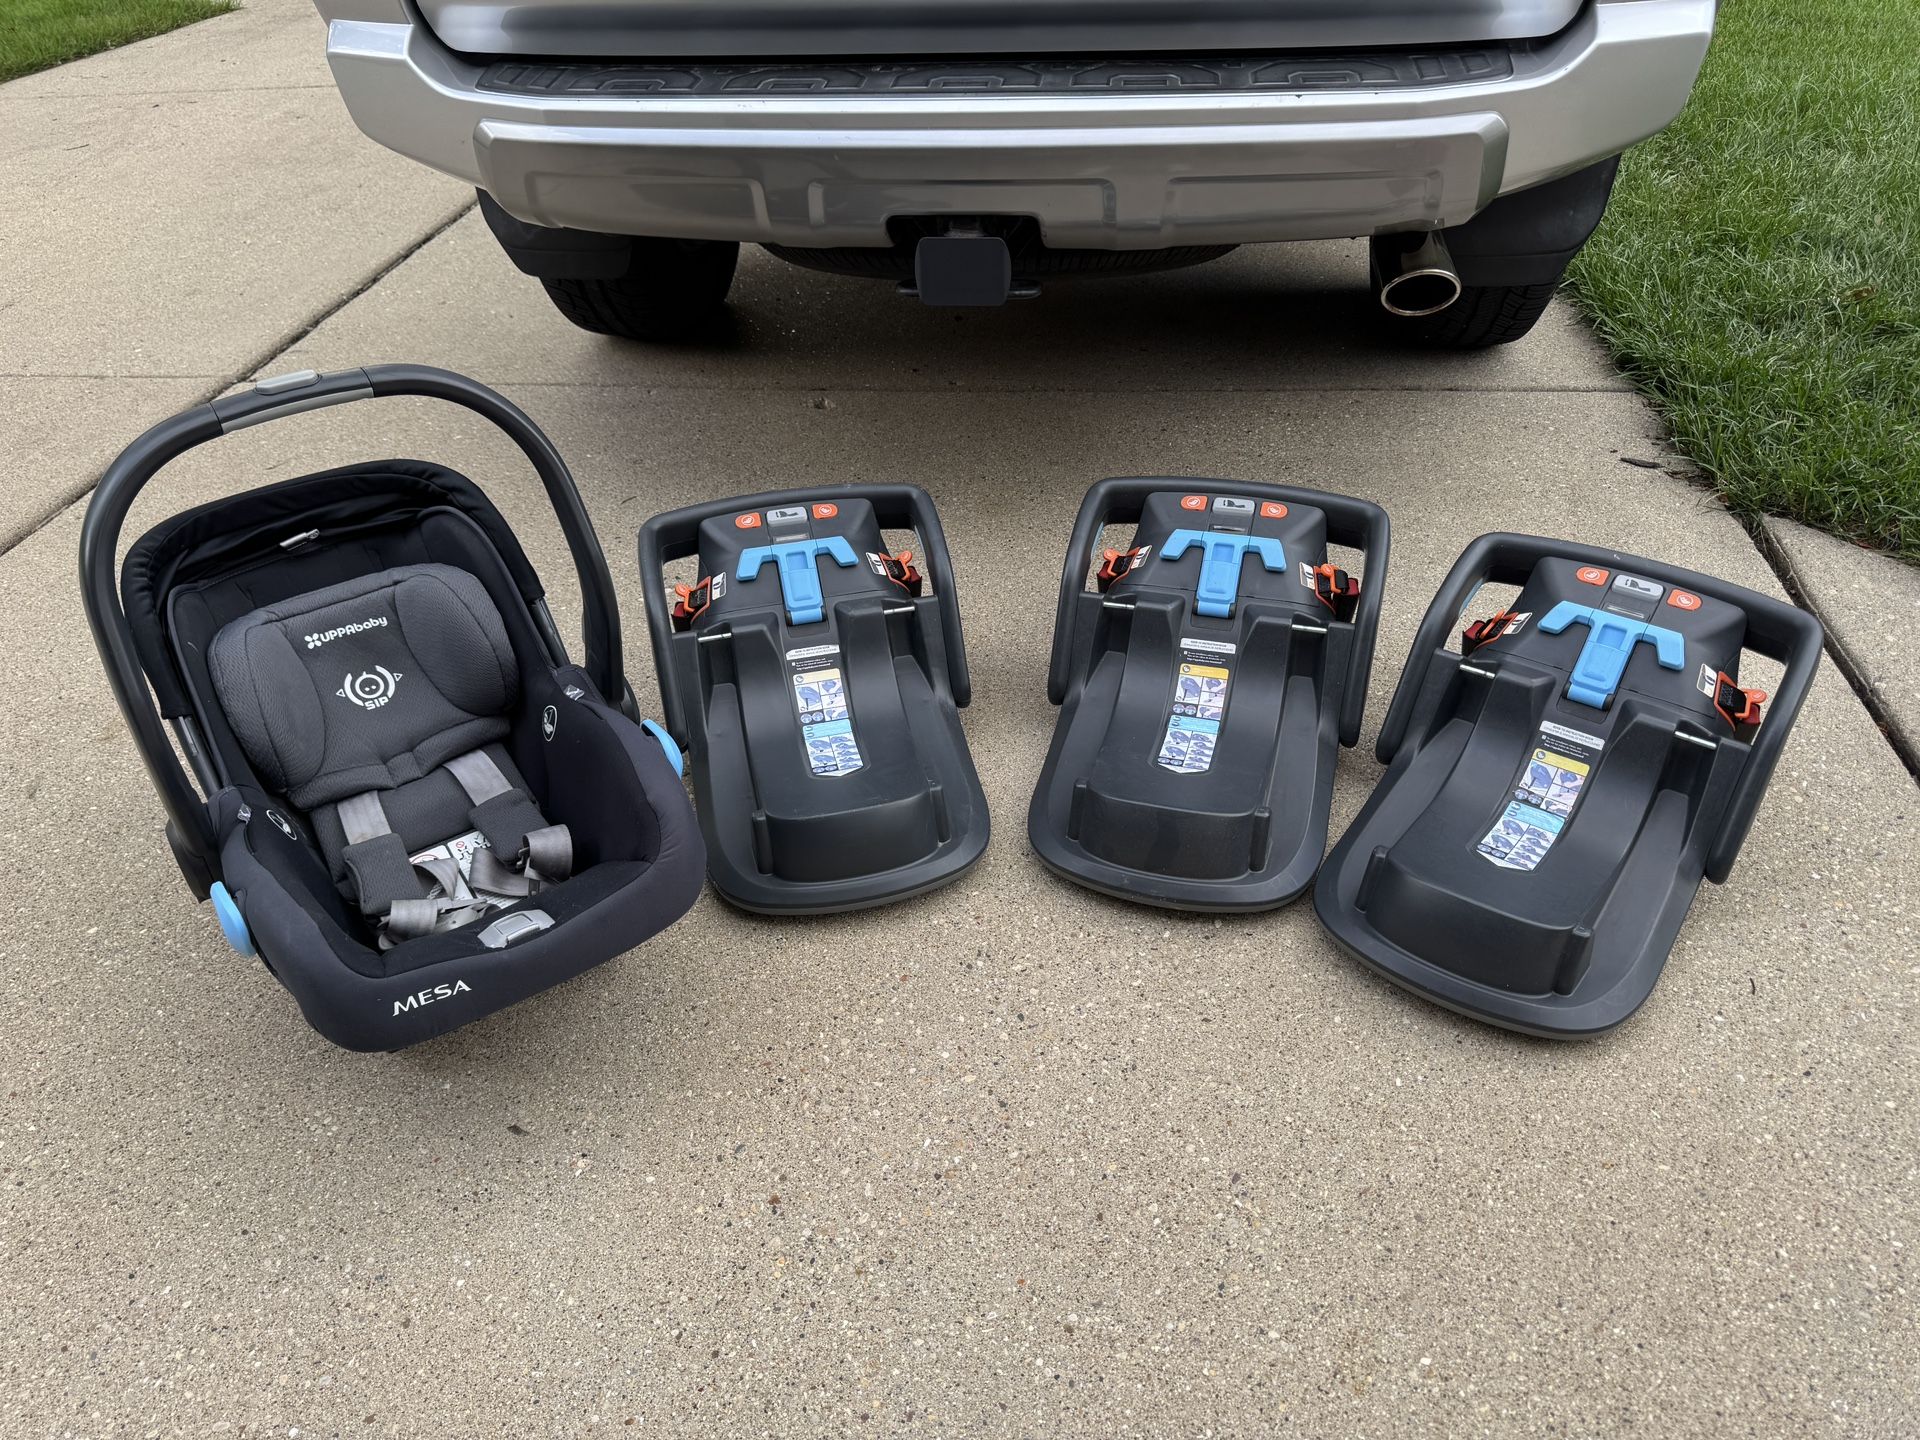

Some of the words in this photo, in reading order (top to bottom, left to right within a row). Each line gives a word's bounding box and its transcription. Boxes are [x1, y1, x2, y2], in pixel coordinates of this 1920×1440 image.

[320, 616, 388, 642] UPPAbaby
[364, 696, 389, 710] SIP
[392, 979, 472, 1017] MESA
